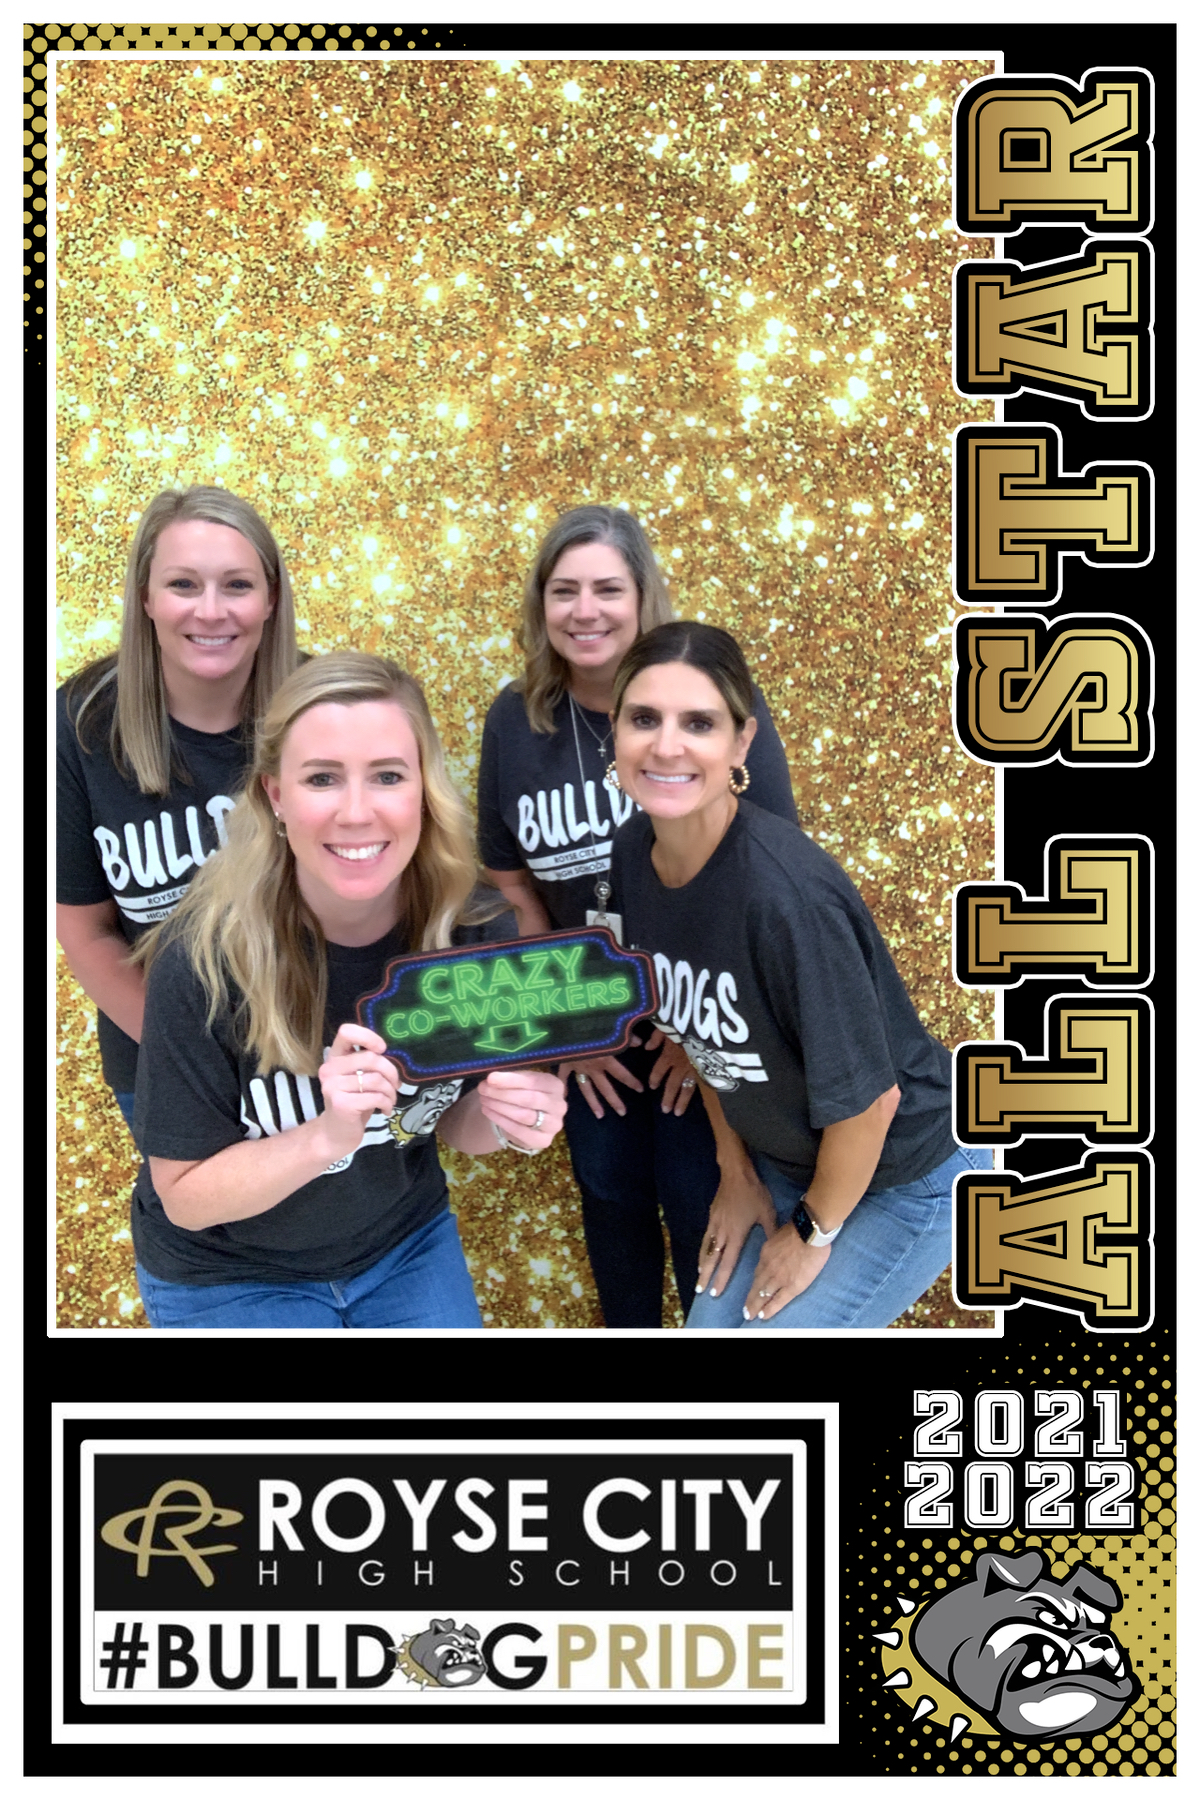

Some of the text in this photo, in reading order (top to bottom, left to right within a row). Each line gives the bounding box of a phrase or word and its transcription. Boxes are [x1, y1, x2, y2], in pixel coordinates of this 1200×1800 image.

[517, 770, 643, 852] BULLD
[554, 852, 577, 863] ROYSE
[147, 889, 178, 904] ROYSE
[146, 910, 169, 920] HIGH
[421, 946, 583, 1004] CRAZY
[386, 977, 631, 1039] CO-WORKERS
